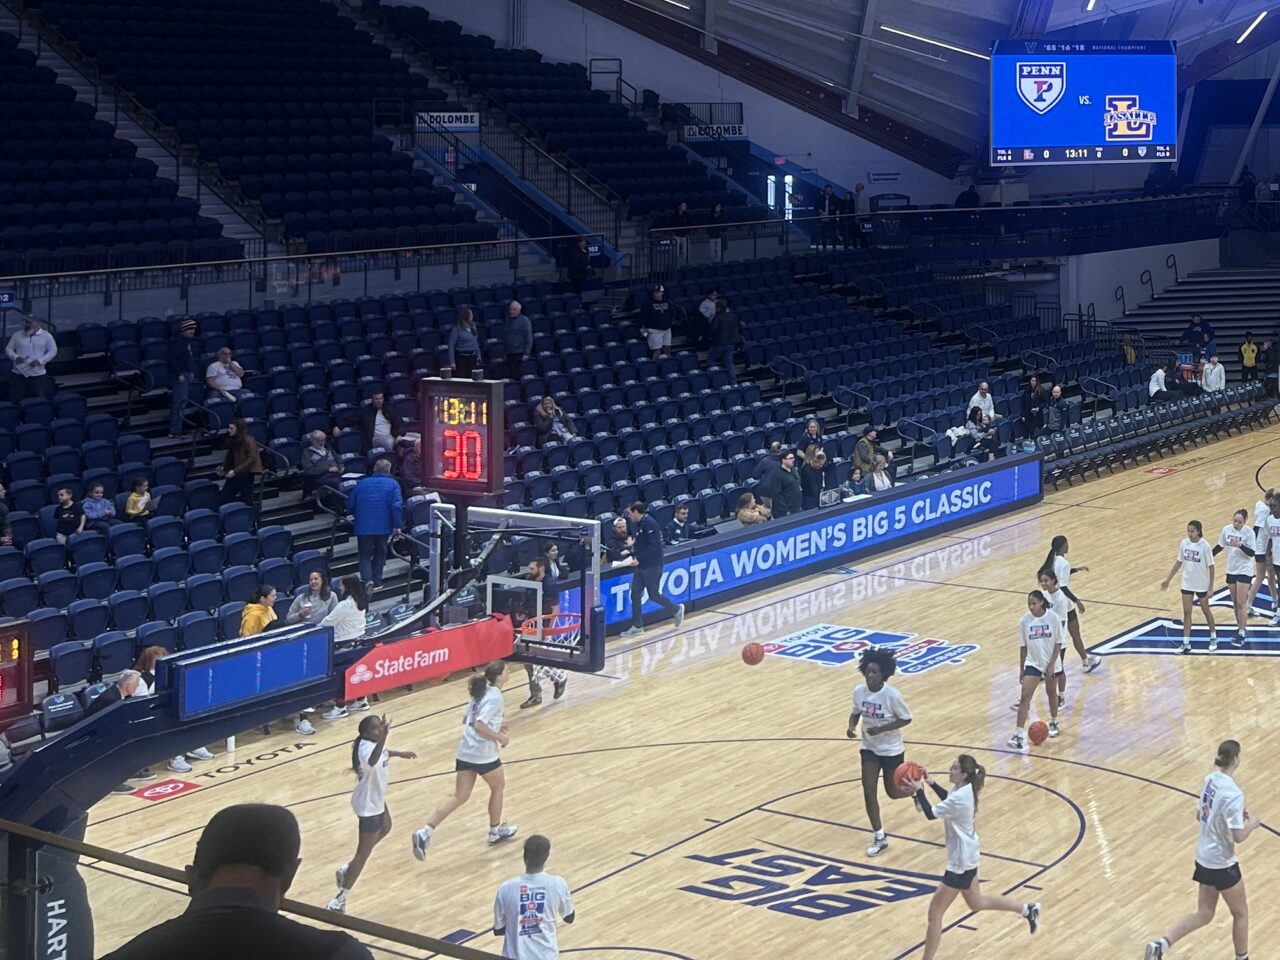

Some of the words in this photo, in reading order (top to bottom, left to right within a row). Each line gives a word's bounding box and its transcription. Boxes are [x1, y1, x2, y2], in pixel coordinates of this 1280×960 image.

[1021, 66, 1061, 76] PENN
[1078, 95, 1092, 106] VS.
[429, 114, 475, 124] COLOMBE
[1043, 149, 1050, 159] 0
[1065, 149, 1088, 159] 13:11
[1122, 148, 1129, 157] 0
[443, 397, 488, 425] 13:11
[443, 429, 483, 480] 30
[730, 523, 847, 576] WOMEN'S
[851, 509, 889, 543] BIG
[893, 505, 907, 530] 5
[910, 480, 993, 522] CLASSIC
[781, 628, 867, 657] BIG
[783, 625, 832, 643] TOYOTA
[907, 645, 971, 672] CLASSIC
[195, 741, 318, 780] TOYOTA
[519, 891, 546, 903] BIG
